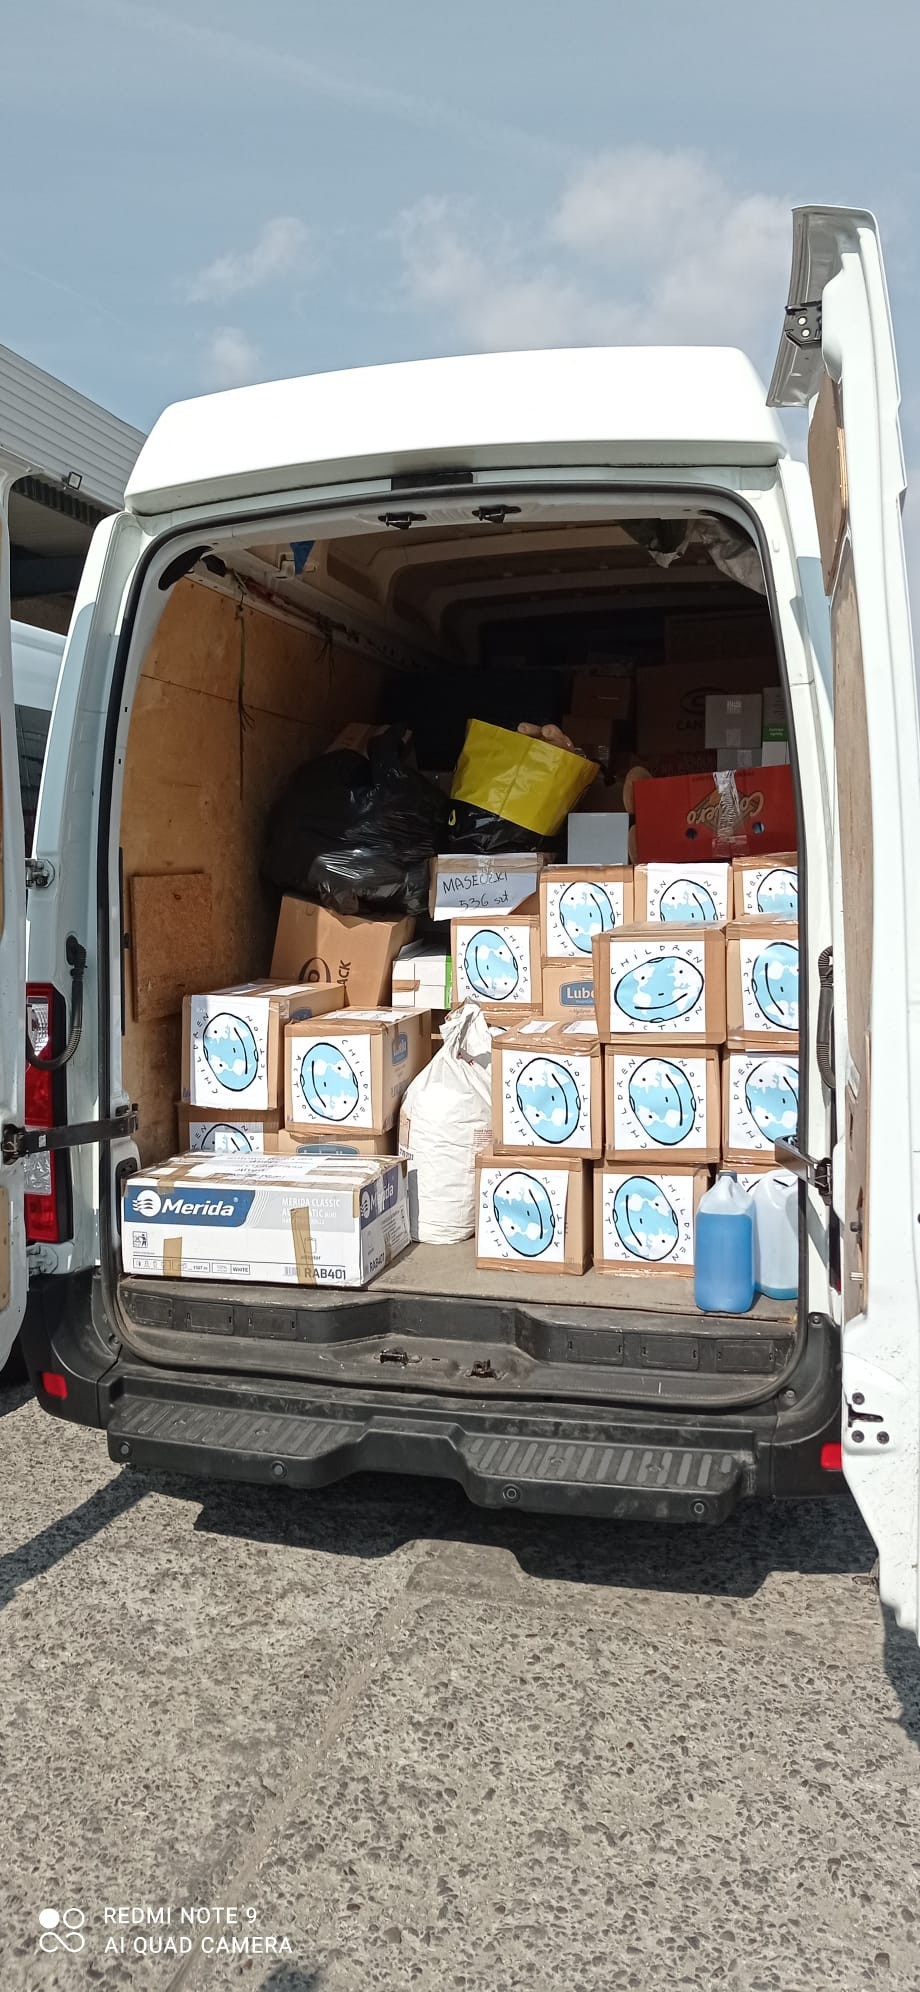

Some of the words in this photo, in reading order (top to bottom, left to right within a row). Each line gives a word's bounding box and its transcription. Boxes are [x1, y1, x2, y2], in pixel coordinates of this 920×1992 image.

[687, 791, 764, 825] Coero
[442, 872, 509, 895] MASECZKI
[459, 893, 489, 911] 536
[337, 960, 352, 984] ACK
[503, 926, 529, 1000] CHILDREN
[566, 987, 595, 999] Lub
[611, 945, 703, 975] CHILDREN
[629, 1006, 703, 1031] ACTION
[743, 957, 772, 1030] ACTION
[193, 1013, 218, 1094] CHILDREN
[246, 1015, 265, 1081] ACTION
[342, 1039, 369, 1121] CHILDREN
[293, 1055, 316, 1120] ACTION
[563, 1059, 589, 1131] ACTION
[617, 1059, 647, 1149] CHILDREN
[678, 1059, 704, 1133] ACTION
[733, 1061, 763, 1149] CHILDREN
[161, 1198, 235, 1218] Merida
[282, 1196, 310, 1207] MERIDA
[482, 1171, 509, 1257] CHILDREN
[542, 1177, 563, 1248] ACTION
[604, 1187, 631, 1259] ACTION
[304, 1267, 346, 1281] RAB401
